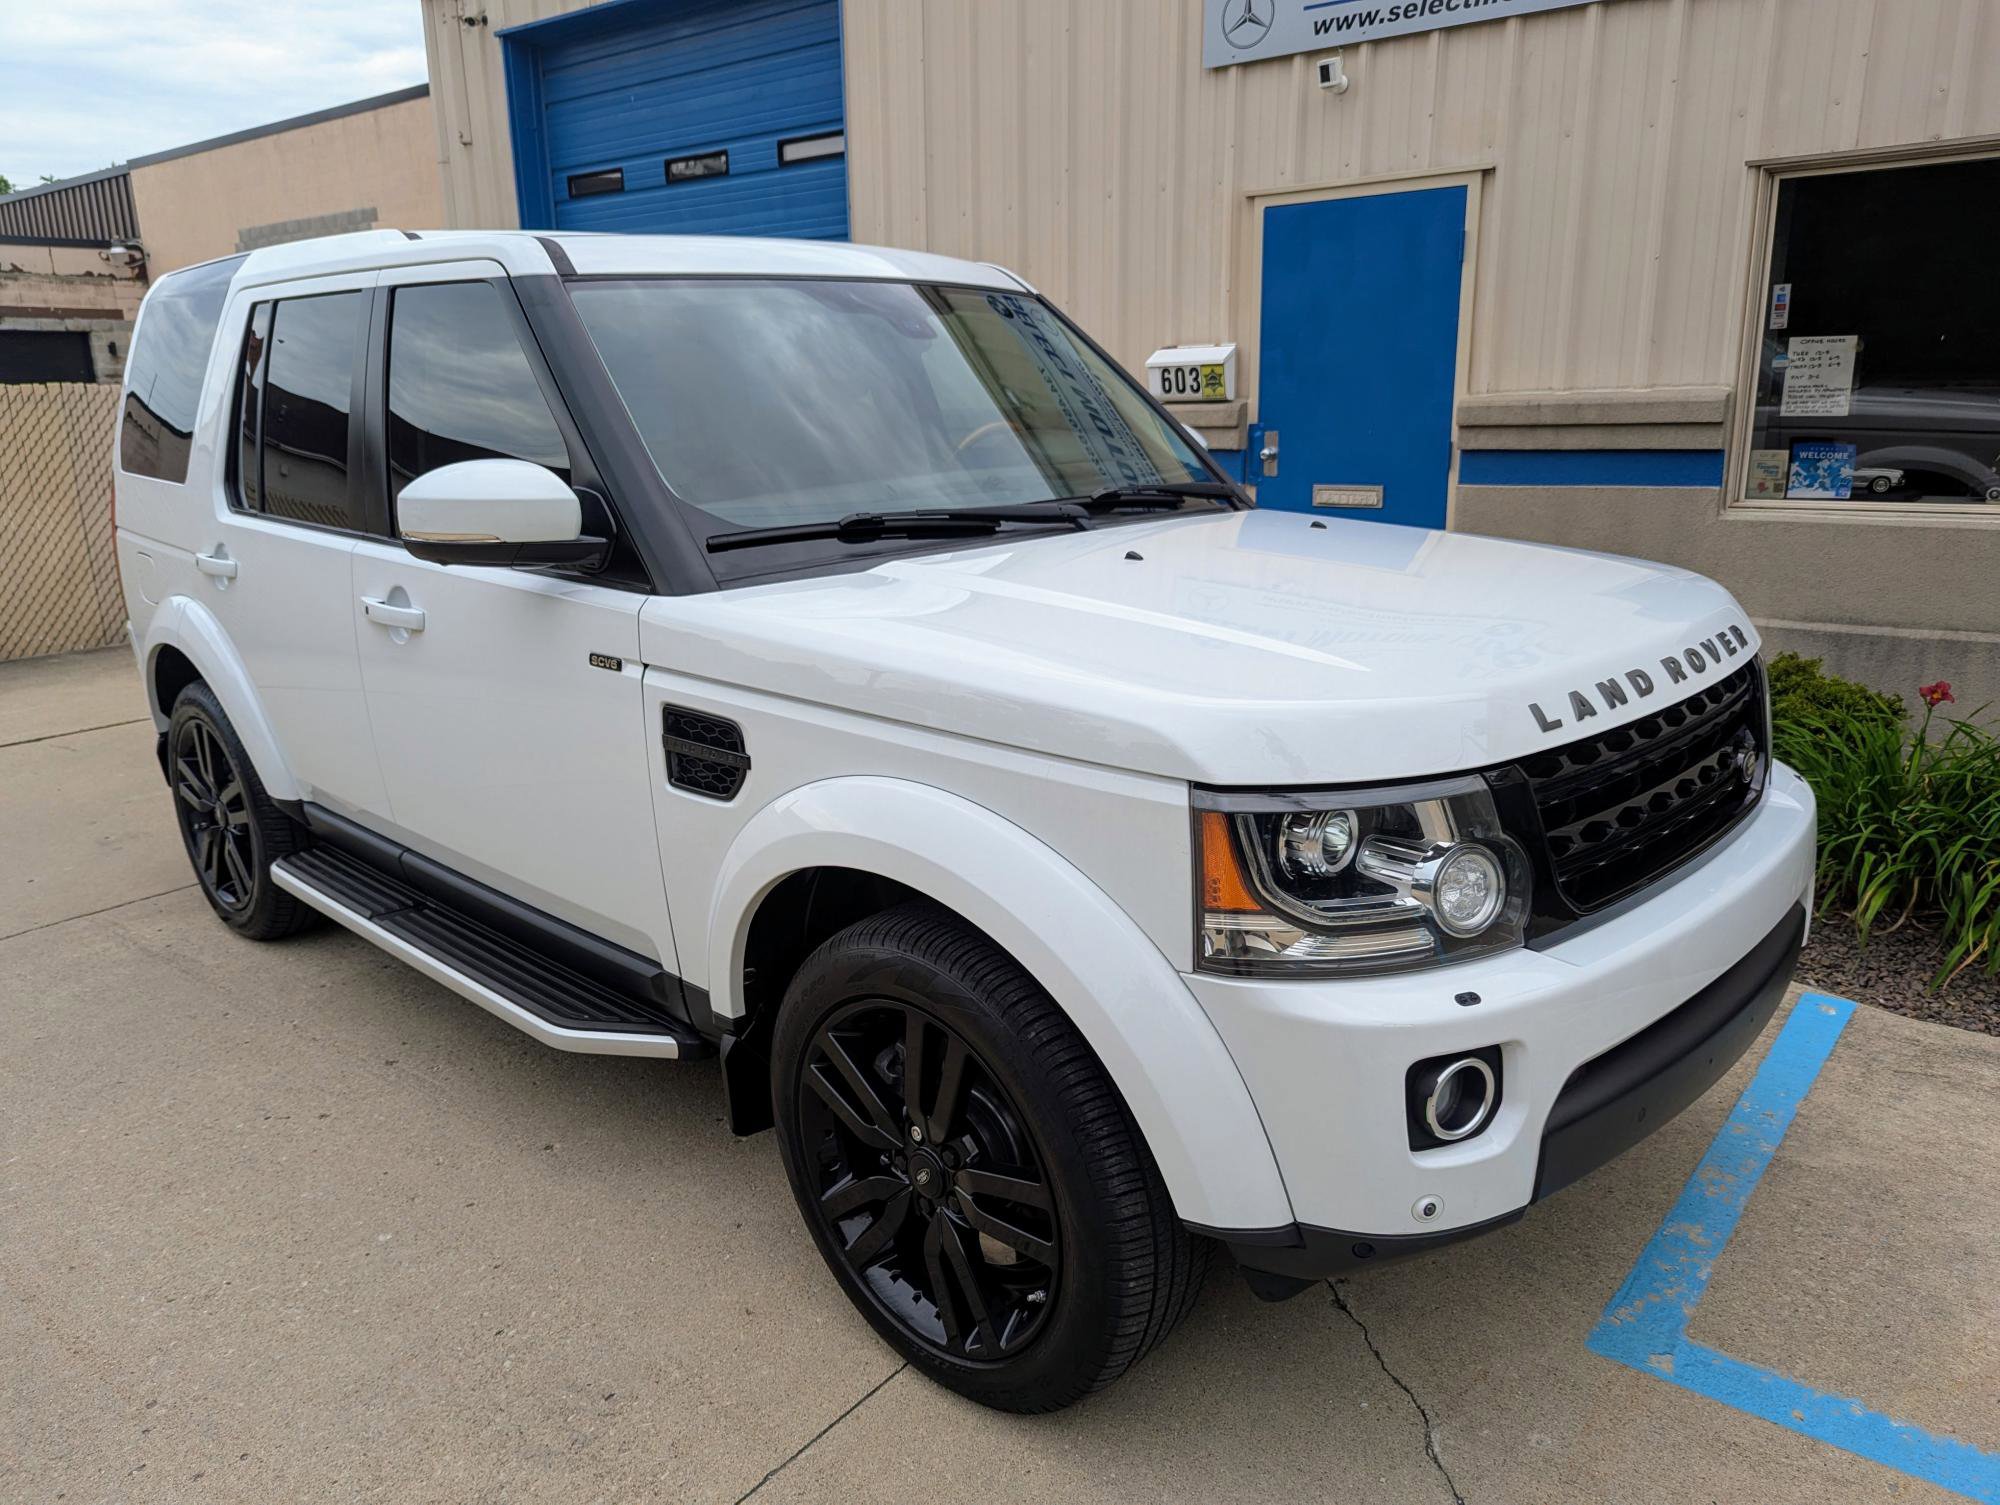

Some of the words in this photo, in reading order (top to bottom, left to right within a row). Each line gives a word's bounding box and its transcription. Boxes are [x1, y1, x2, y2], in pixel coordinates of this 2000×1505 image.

[1313, 0, 1512, 36] www.selec
[1161, 367, 1200, 394] 603
[1799, 451, 1849, 460] WELCOME
[591, 655, 618, 669] SCV6
[1528, 668, 1655, 733] LAND
[1659, 624, 1749, 685] ROVER
